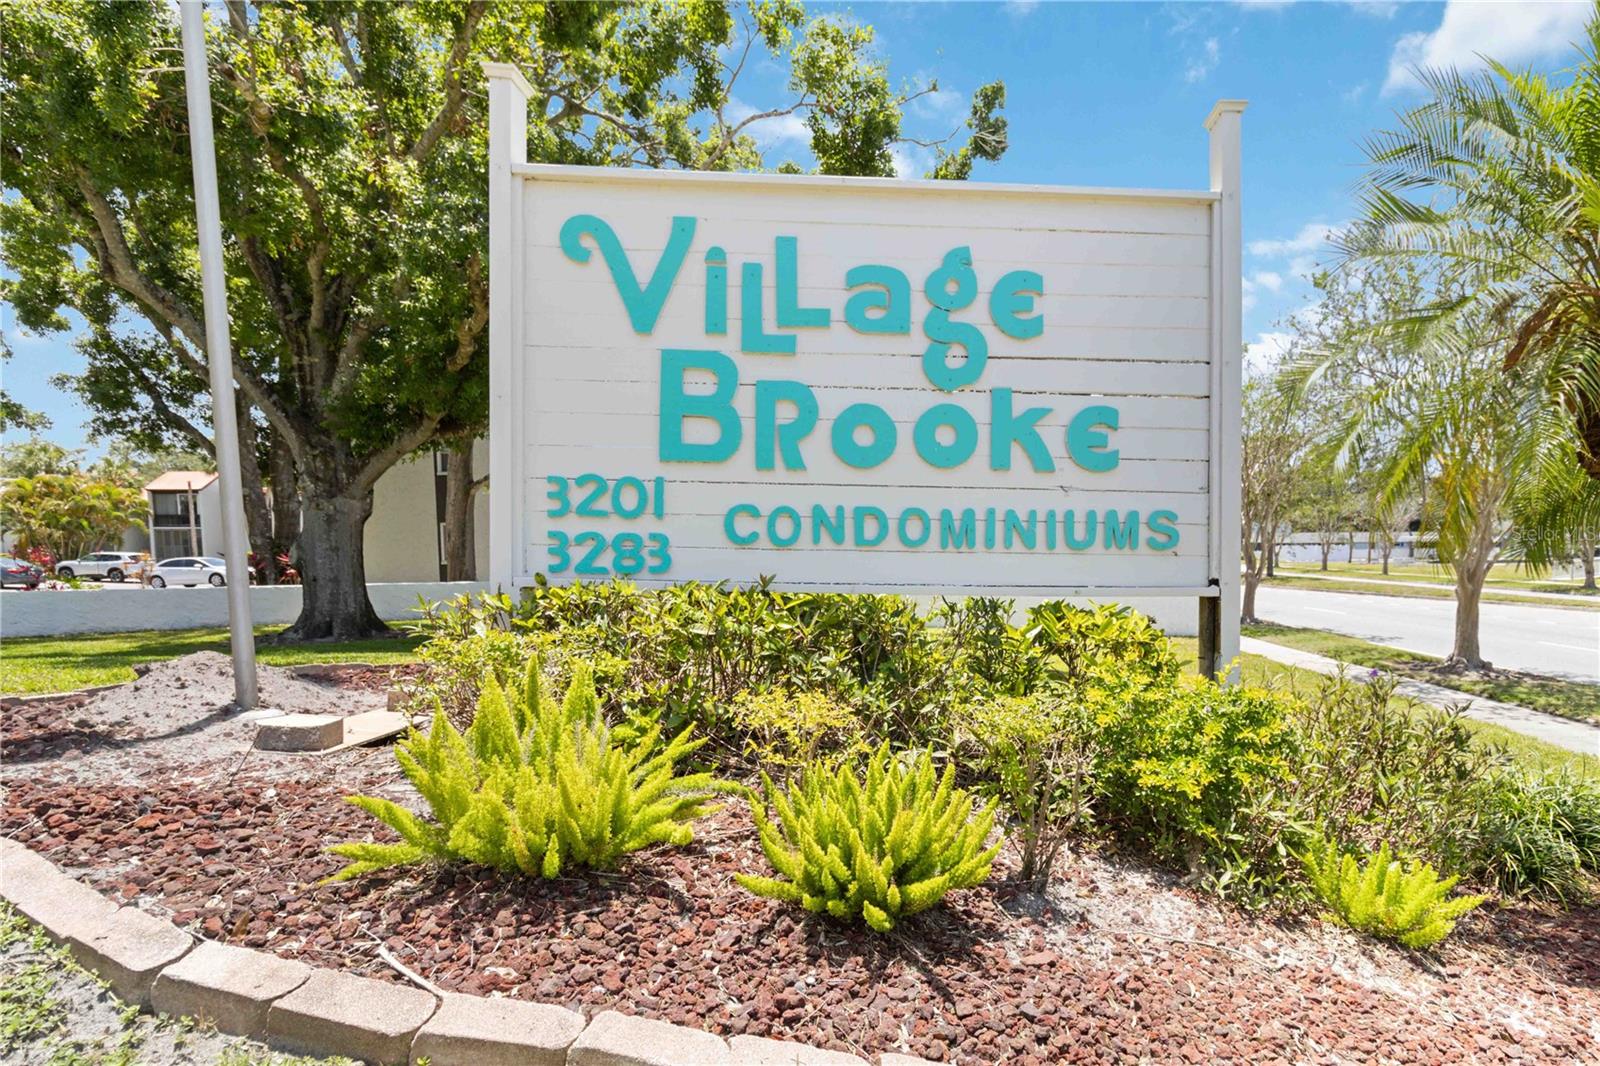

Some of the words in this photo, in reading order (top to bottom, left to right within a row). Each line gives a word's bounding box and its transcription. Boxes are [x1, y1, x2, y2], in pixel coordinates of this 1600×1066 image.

[547, 474, 665, 519] 3201
[724, 503, 1180, 550] CONDOMINIUMS
[547, 531, 673, 575] 3283
